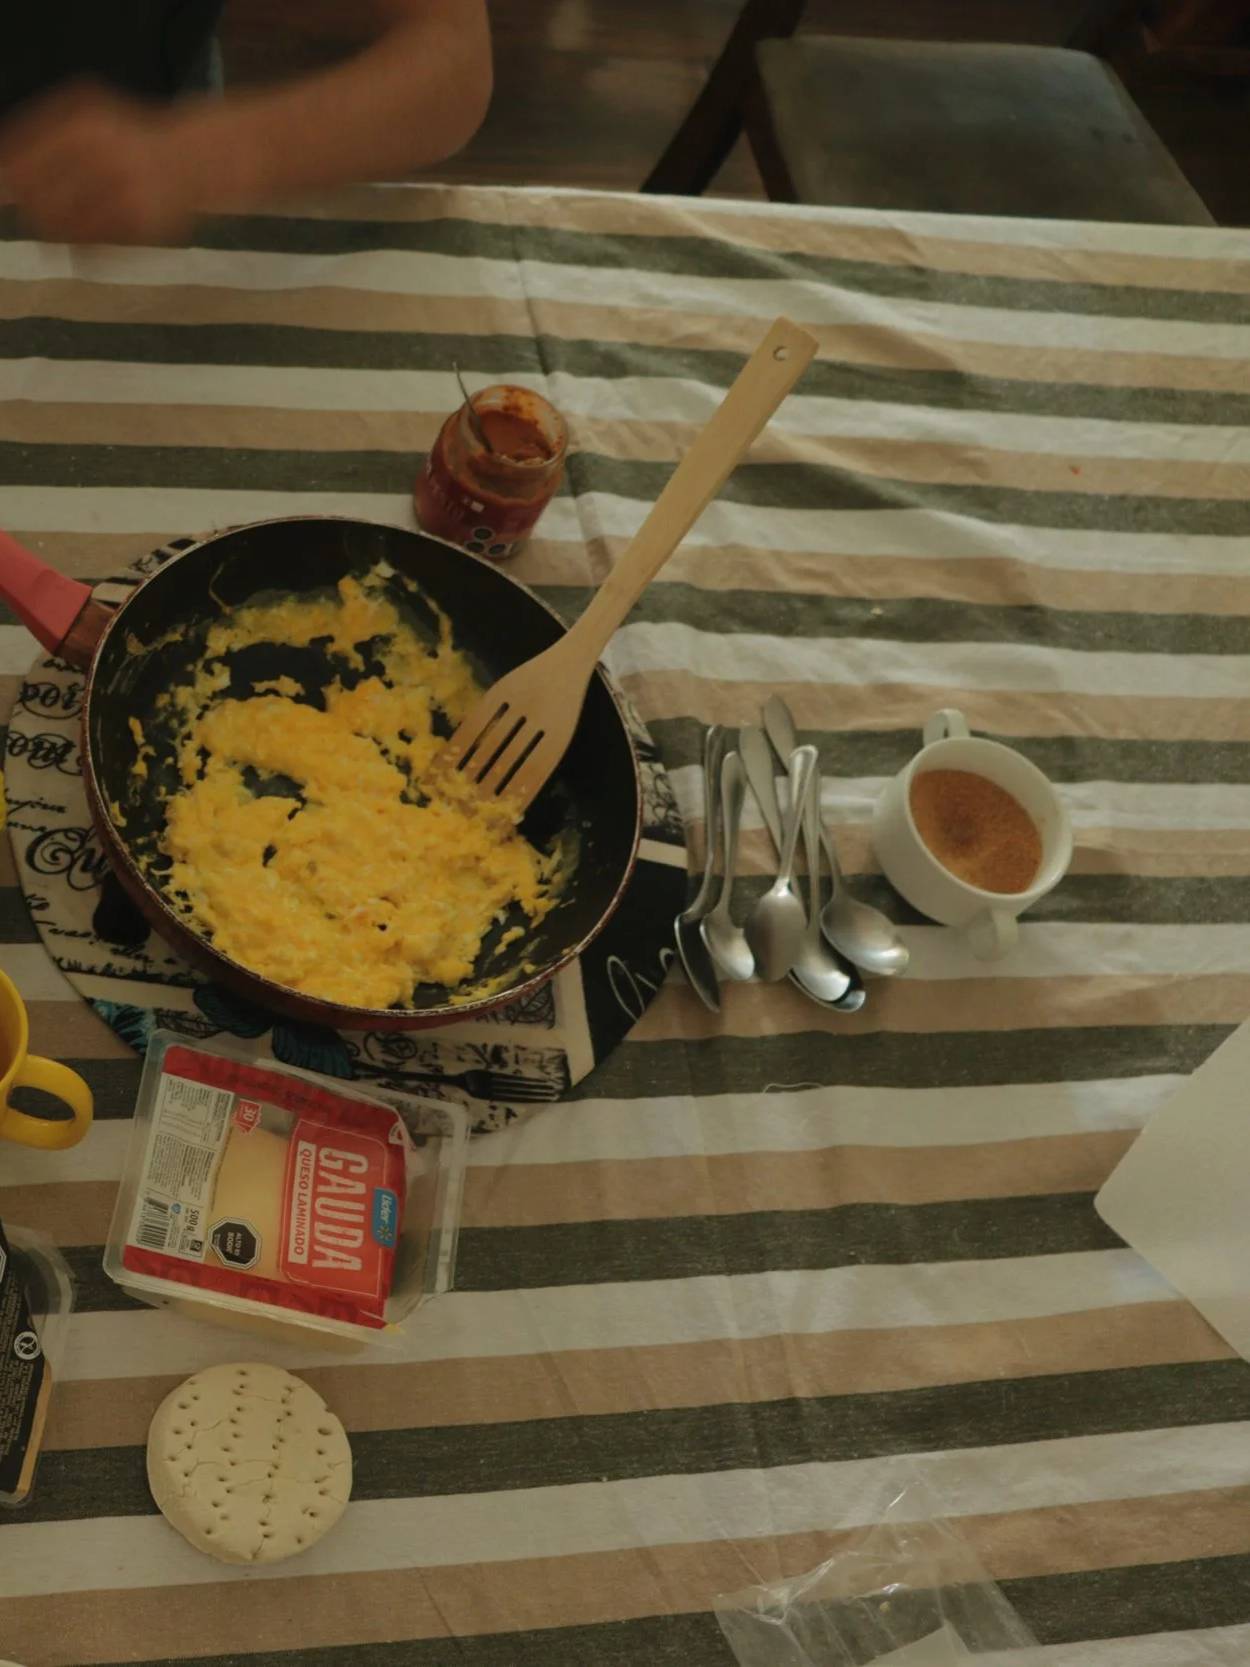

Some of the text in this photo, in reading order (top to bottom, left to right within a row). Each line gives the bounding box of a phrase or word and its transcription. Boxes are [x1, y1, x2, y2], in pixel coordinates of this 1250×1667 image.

[242, 1107, 258, 1122] 30
[189, 1209, 200, 1226] 500
[293, 1148, 312, 1256] QUESO LAMINADO
[312, 1147, 368, 1271] GAUDA
